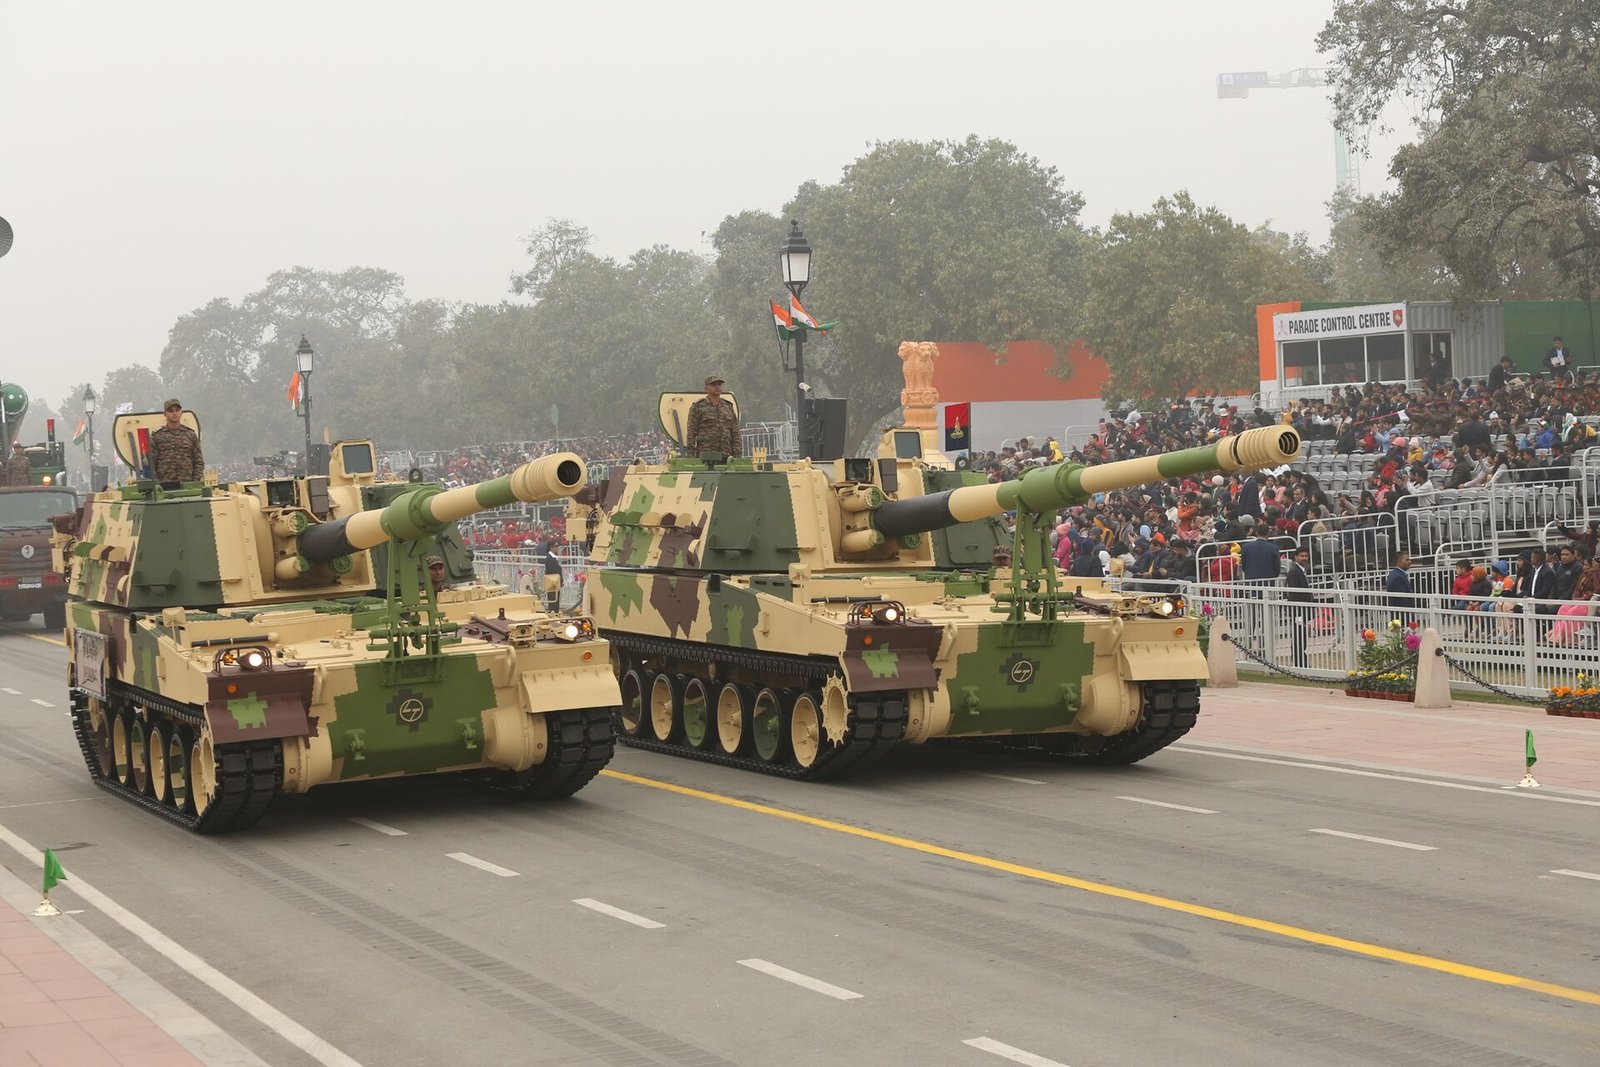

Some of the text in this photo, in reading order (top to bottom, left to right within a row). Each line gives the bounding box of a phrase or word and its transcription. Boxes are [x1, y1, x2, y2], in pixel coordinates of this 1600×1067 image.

[1289, 312, 1391, 334] PARADE CONTROL CENTRE
